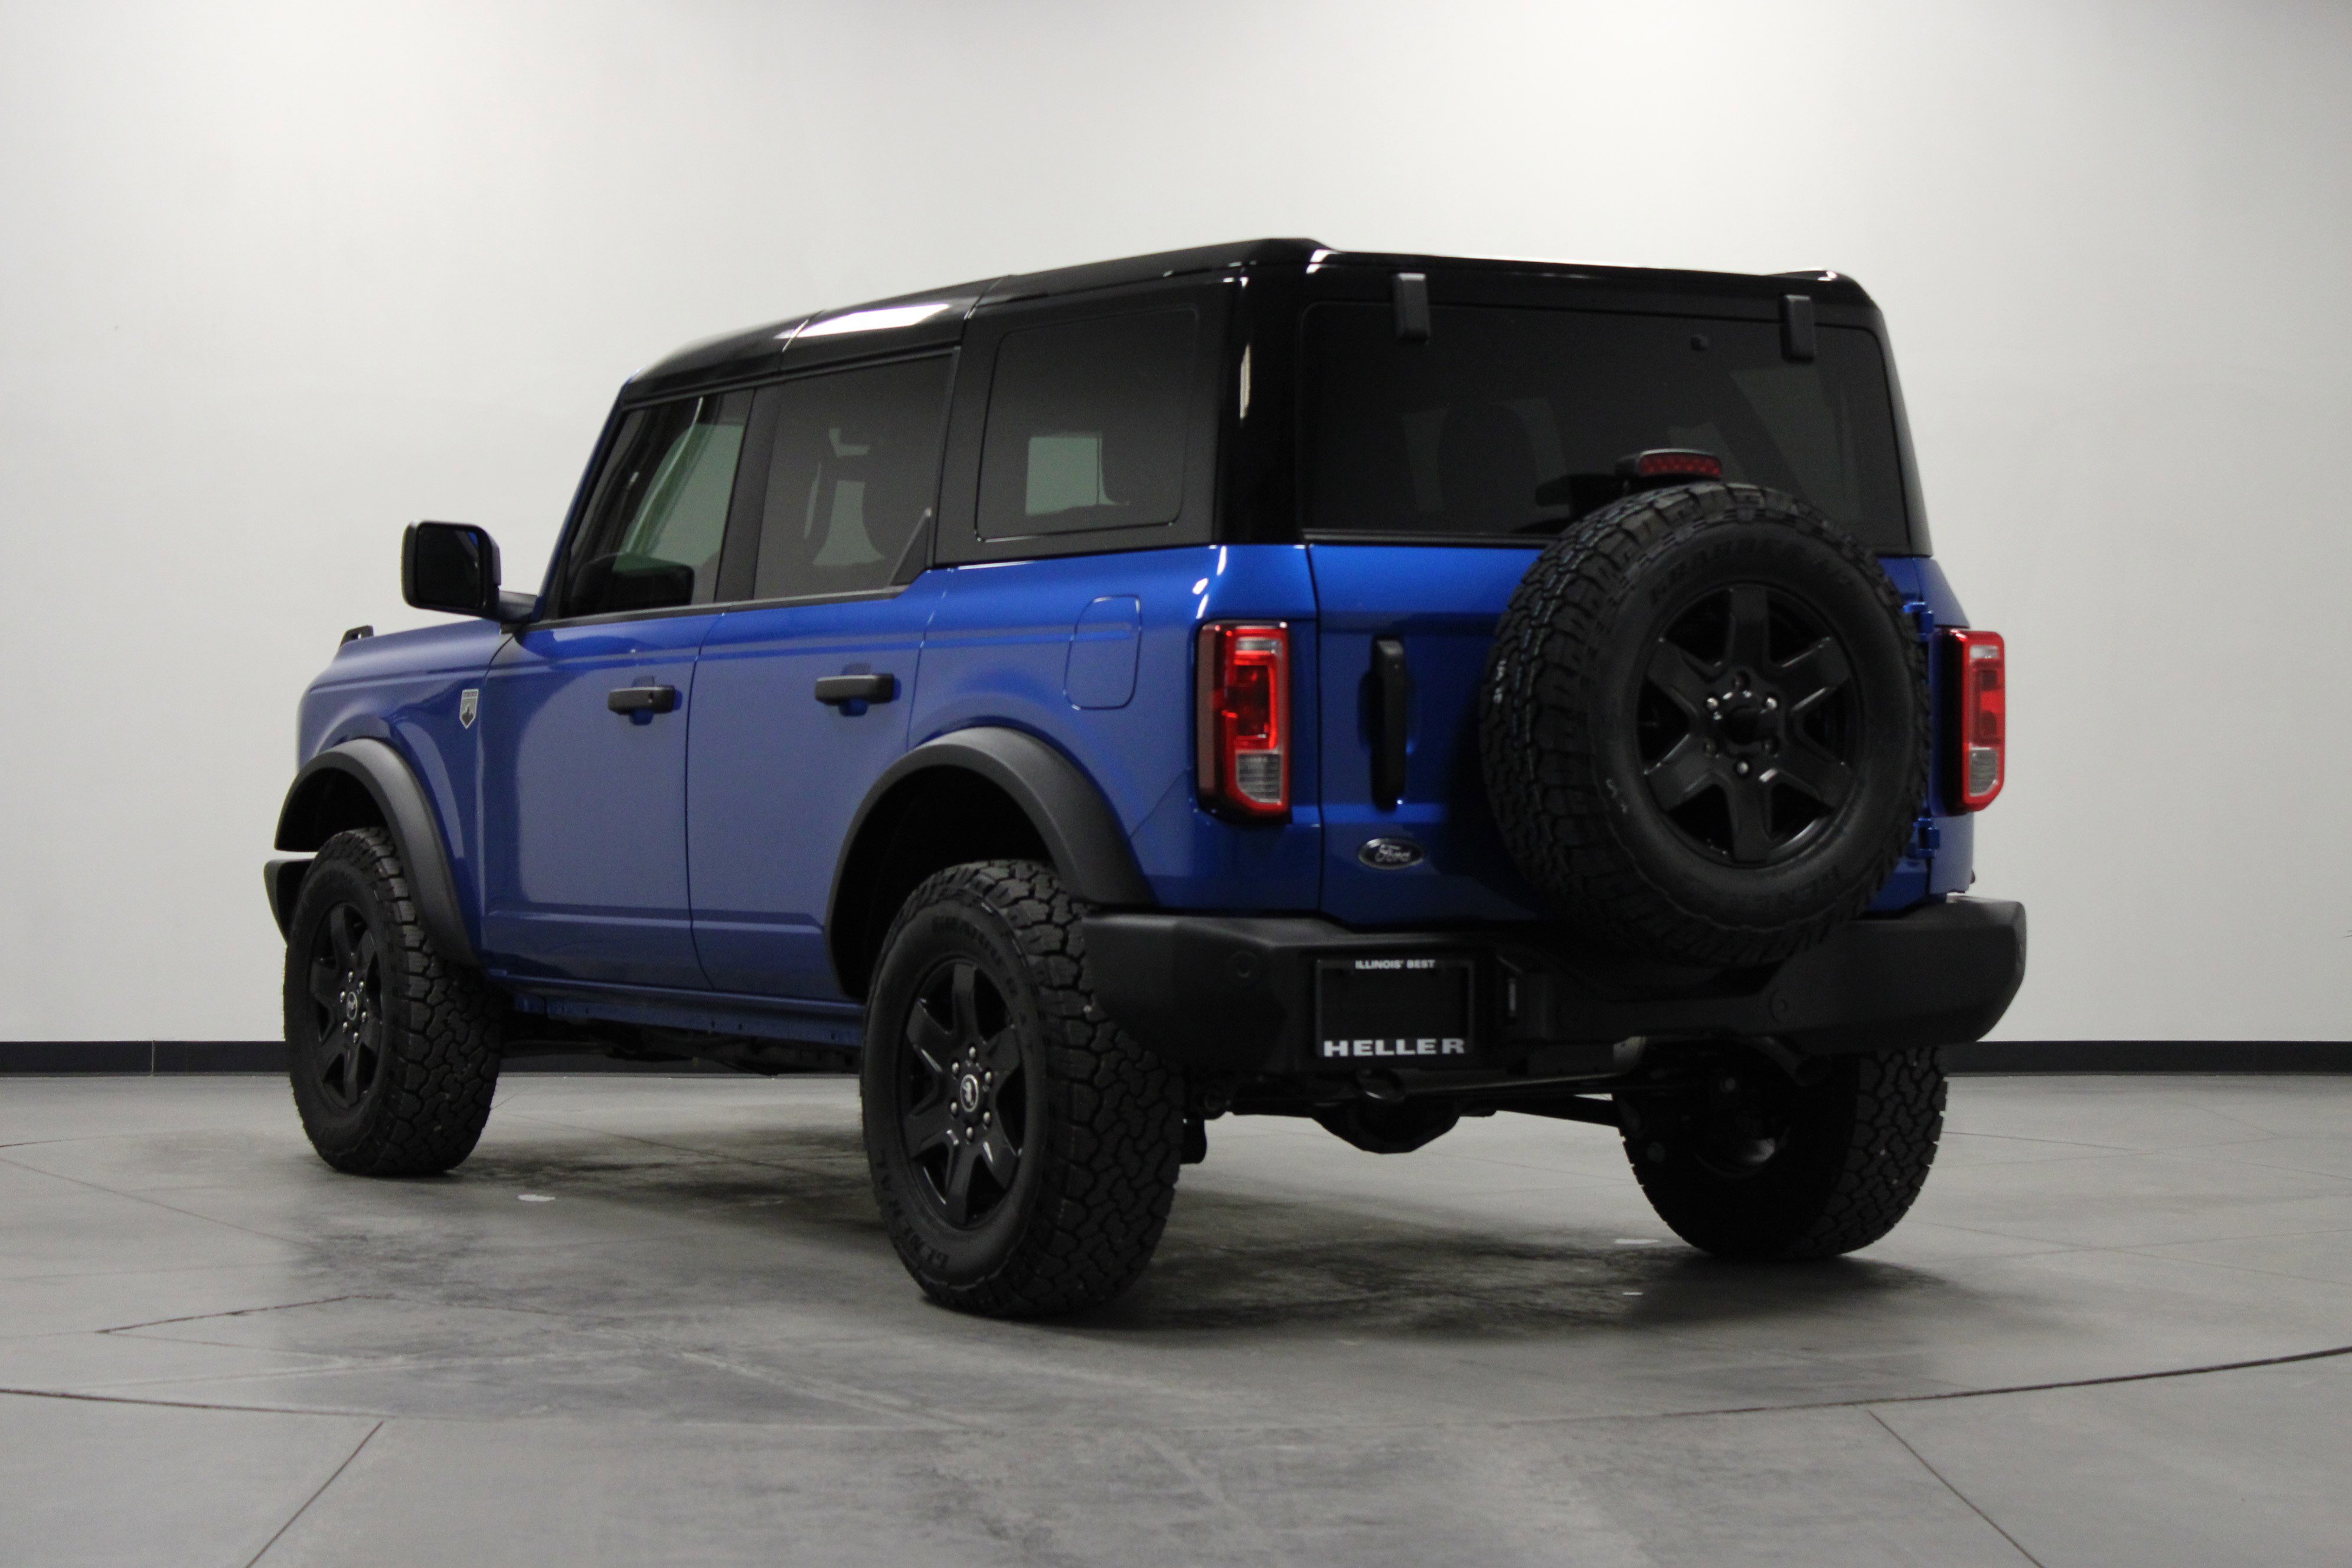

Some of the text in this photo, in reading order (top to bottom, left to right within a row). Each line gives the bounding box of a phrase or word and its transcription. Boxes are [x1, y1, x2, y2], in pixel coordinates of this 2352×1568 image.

[1374, 843, 1412, 863] Ford
[1355, 959, 1436, 969] ILLINOIS' BEST
[1323, 1038, 1465, 1057] HELLER
